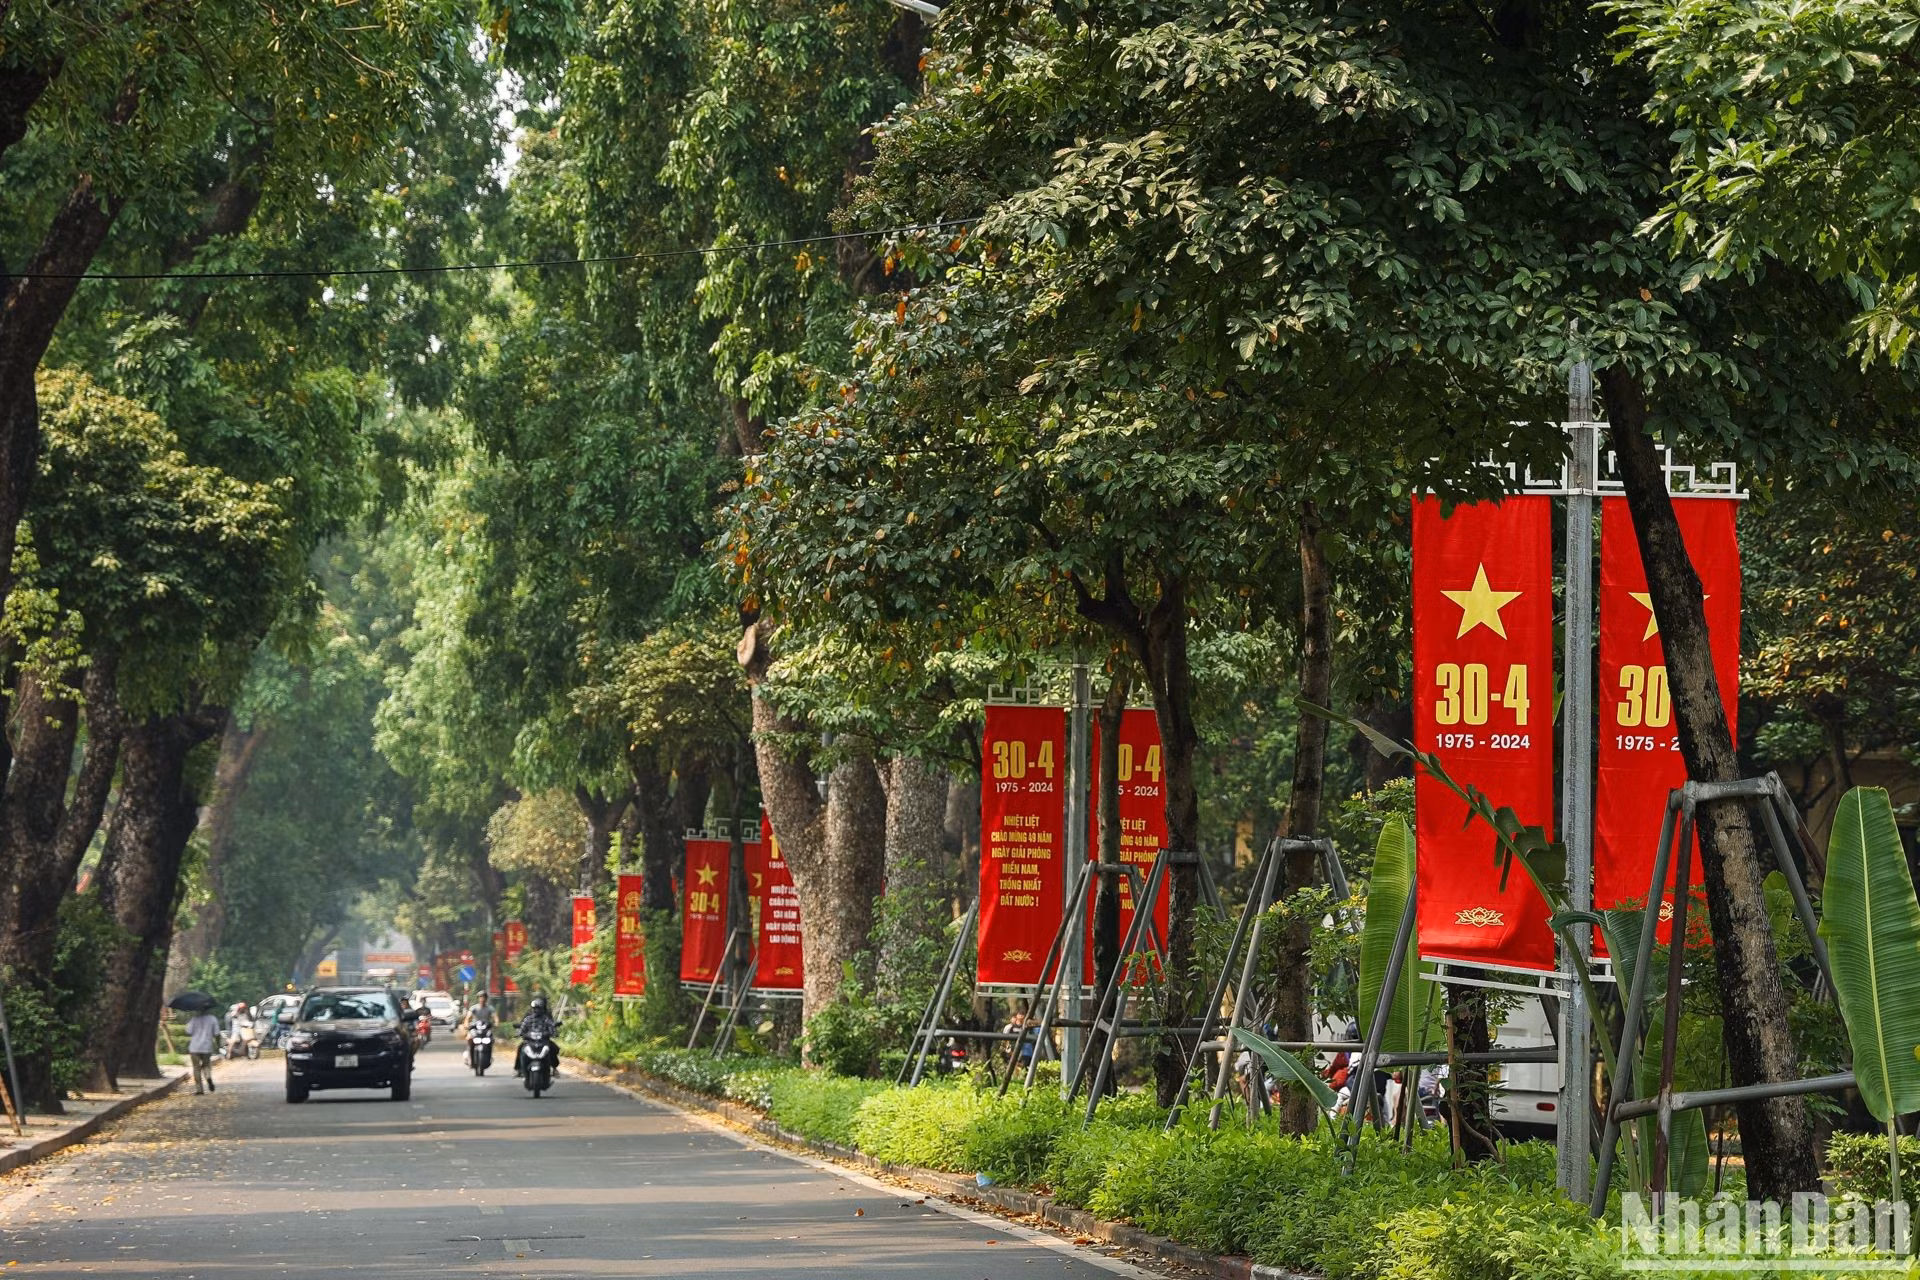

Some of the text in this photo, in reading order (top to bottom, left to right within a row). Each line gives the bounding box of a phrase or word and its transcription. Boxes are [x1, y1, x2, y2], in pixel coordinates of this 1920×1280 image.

[1435, 663, 1531, 726] 30-4
[1616, 664, 1672, 728] 30
[1435, 734, 1475, 749] 1975
[1490, 734, 1531, 749] 2024
[1615, 735, 1655, 750] 1975
[992, 740, 1055, 779] 30-4
[1118, 743, 1162, 783] 0-4
[995, 782, 1019, 793] 1975
[1028, 782, 1054, 793] 2024
[1134, 785, 1159, 797] 2024
[1003, 814, 1040, 829] NHIỆT LIỆT
[1131, 817, 1147, 833] LIỆT
[991, 829, 1008, 842] CHÀO
[1028, 832, 1037, 843] 49
[1037, 830, 1053, 843] NĂM
[1120, 833, 1134, 846] ỪNG
[1134, 835, 1143, 847] 49
[991, 845, 1010, 858] NGÀY
[1011, 845, 1026, 858] GIẢI
[999, 876, 1042, 891] THỐNG NHẤT
[690, 891, 720, 914] 30-4
